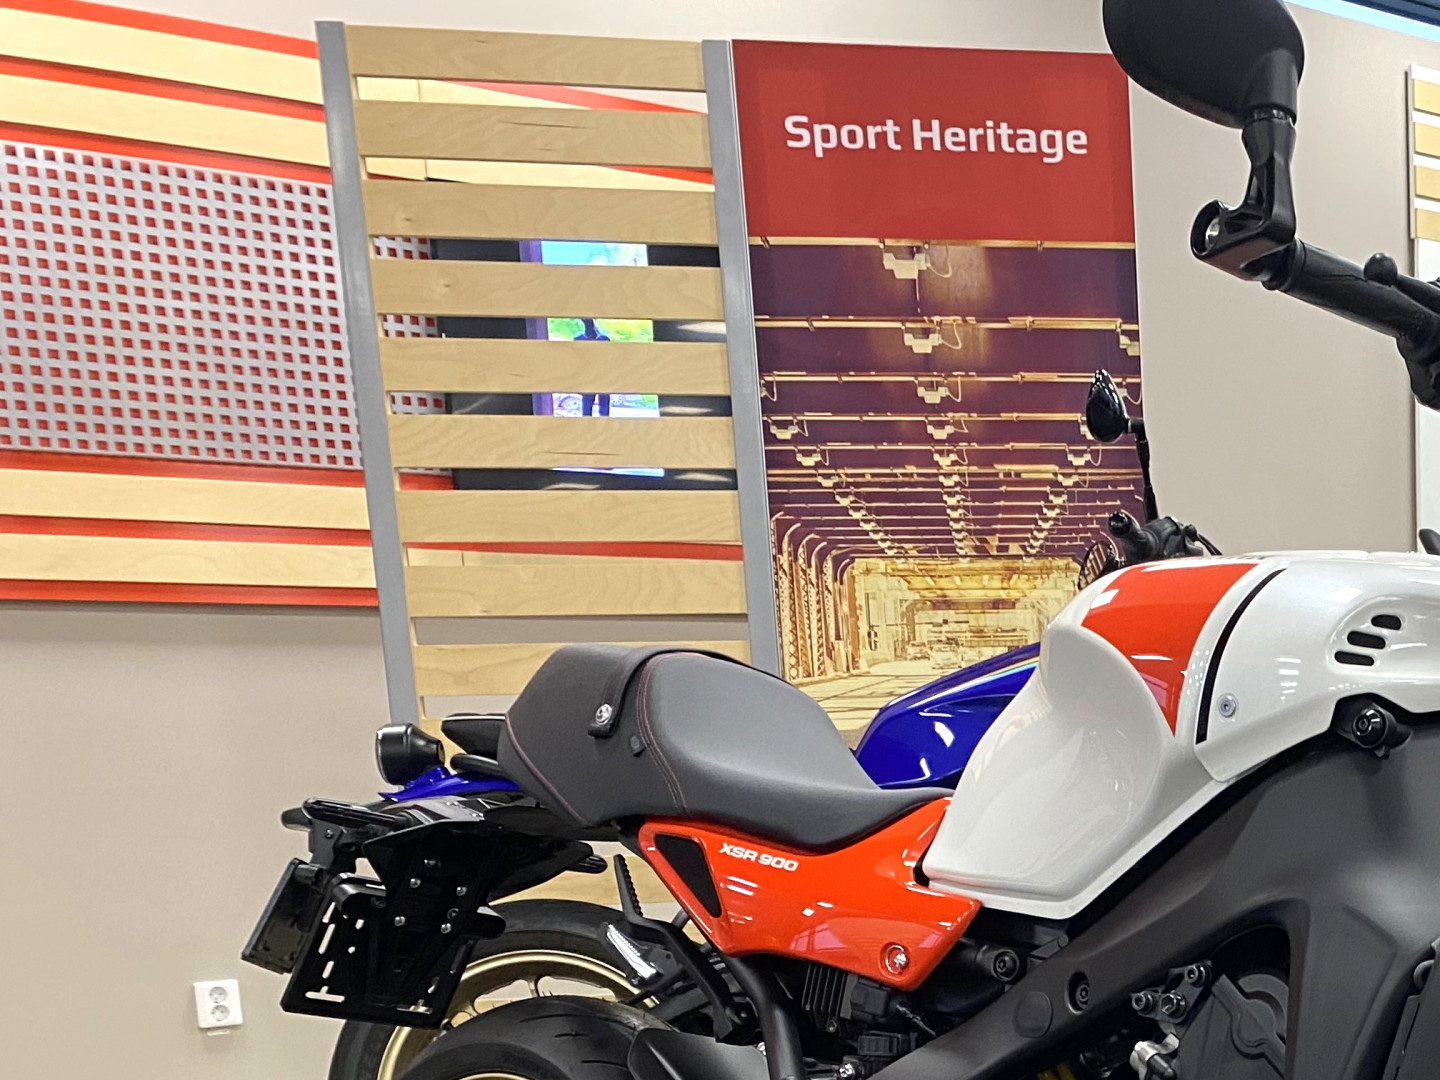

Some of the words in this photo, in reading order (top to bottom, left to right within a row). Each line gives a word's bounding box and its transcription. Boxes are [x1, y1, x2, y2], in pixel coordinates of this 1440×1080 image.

[784, 114, 902, 158] Sport
[912, 118, 1088, 164] Heritage
[718, 842, 759, 863] XSR
[758, 853, 799, 872] 900
